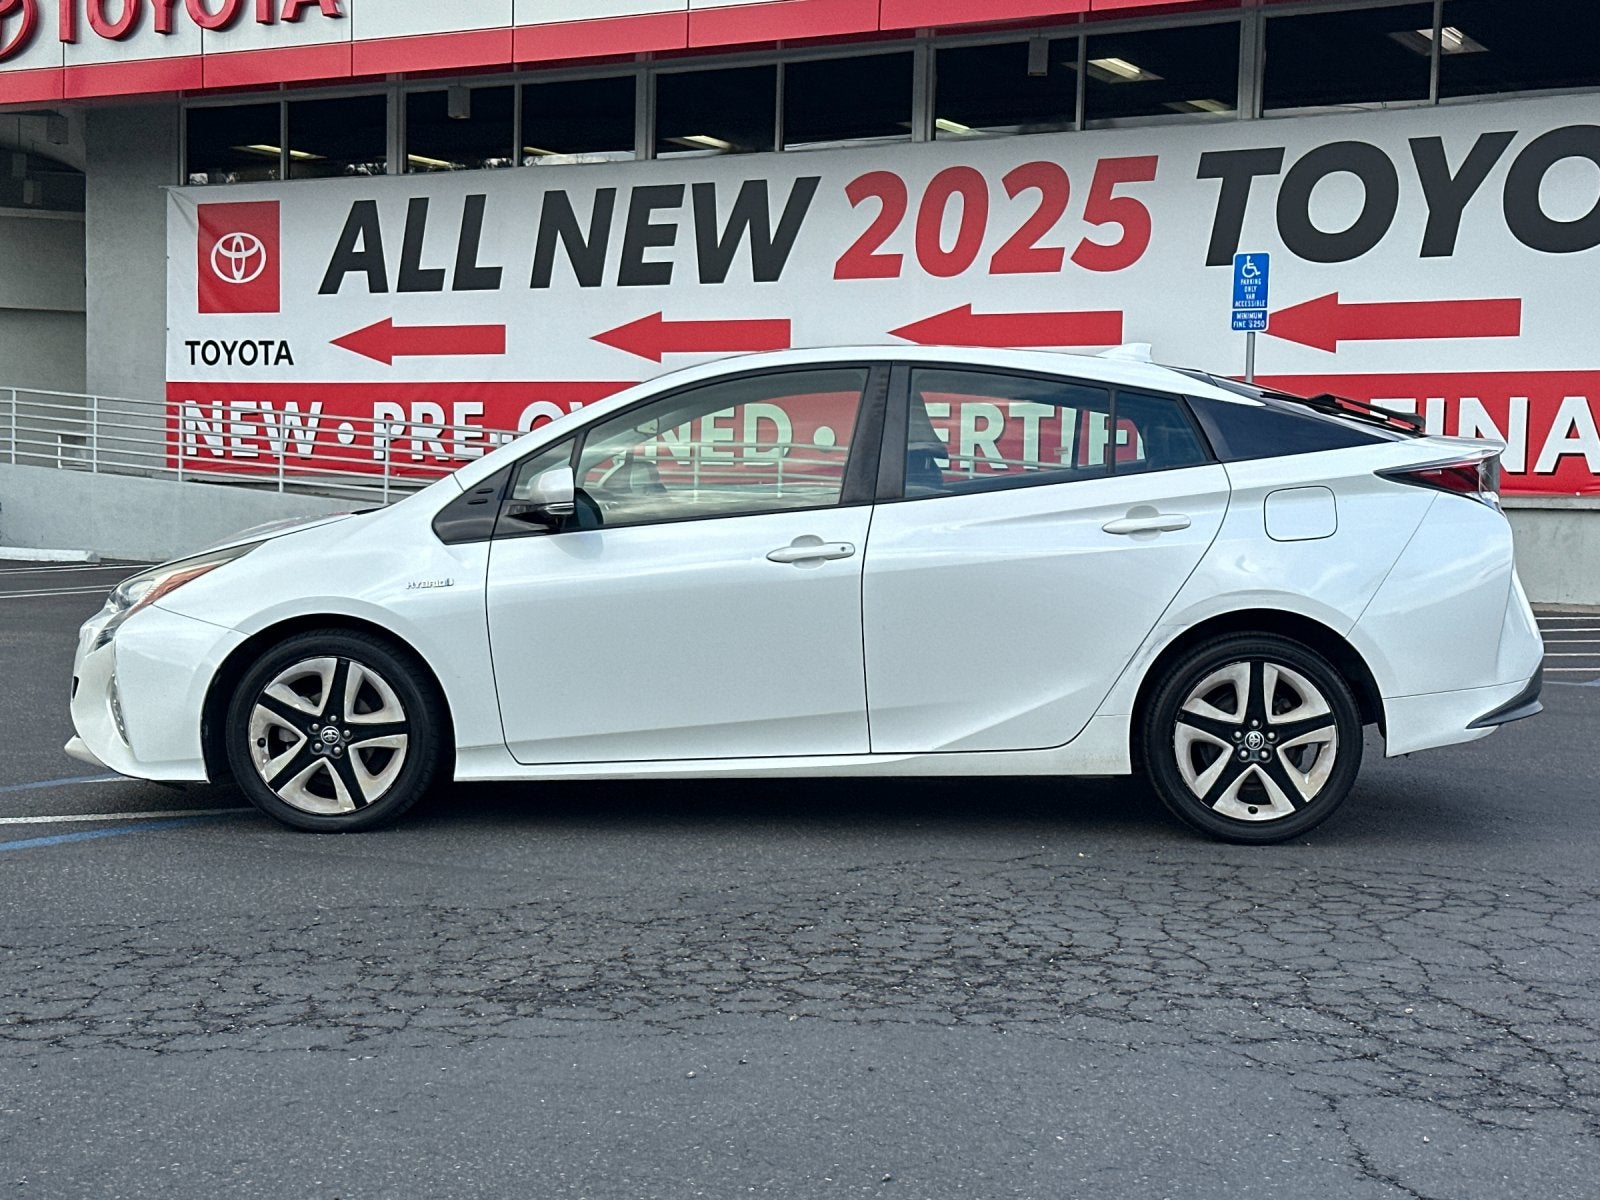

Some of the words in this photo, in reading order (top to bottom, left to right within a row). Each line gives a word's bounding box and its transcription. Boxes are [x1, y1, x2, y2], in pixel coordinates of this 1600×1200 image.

[318, 194, 503, 295] ALL
[530, 176, 822, 288] NEW
[834, 155, 1159, 281] 2025
[1197, 124, 1600, 267] TOYO
[1240, 278, 1262, 286] PARKING
[1248, 320, 1266, 328] $250
[185, 340, 294, 366] TOYOTA
[184, 400, 323, 459] NEW
